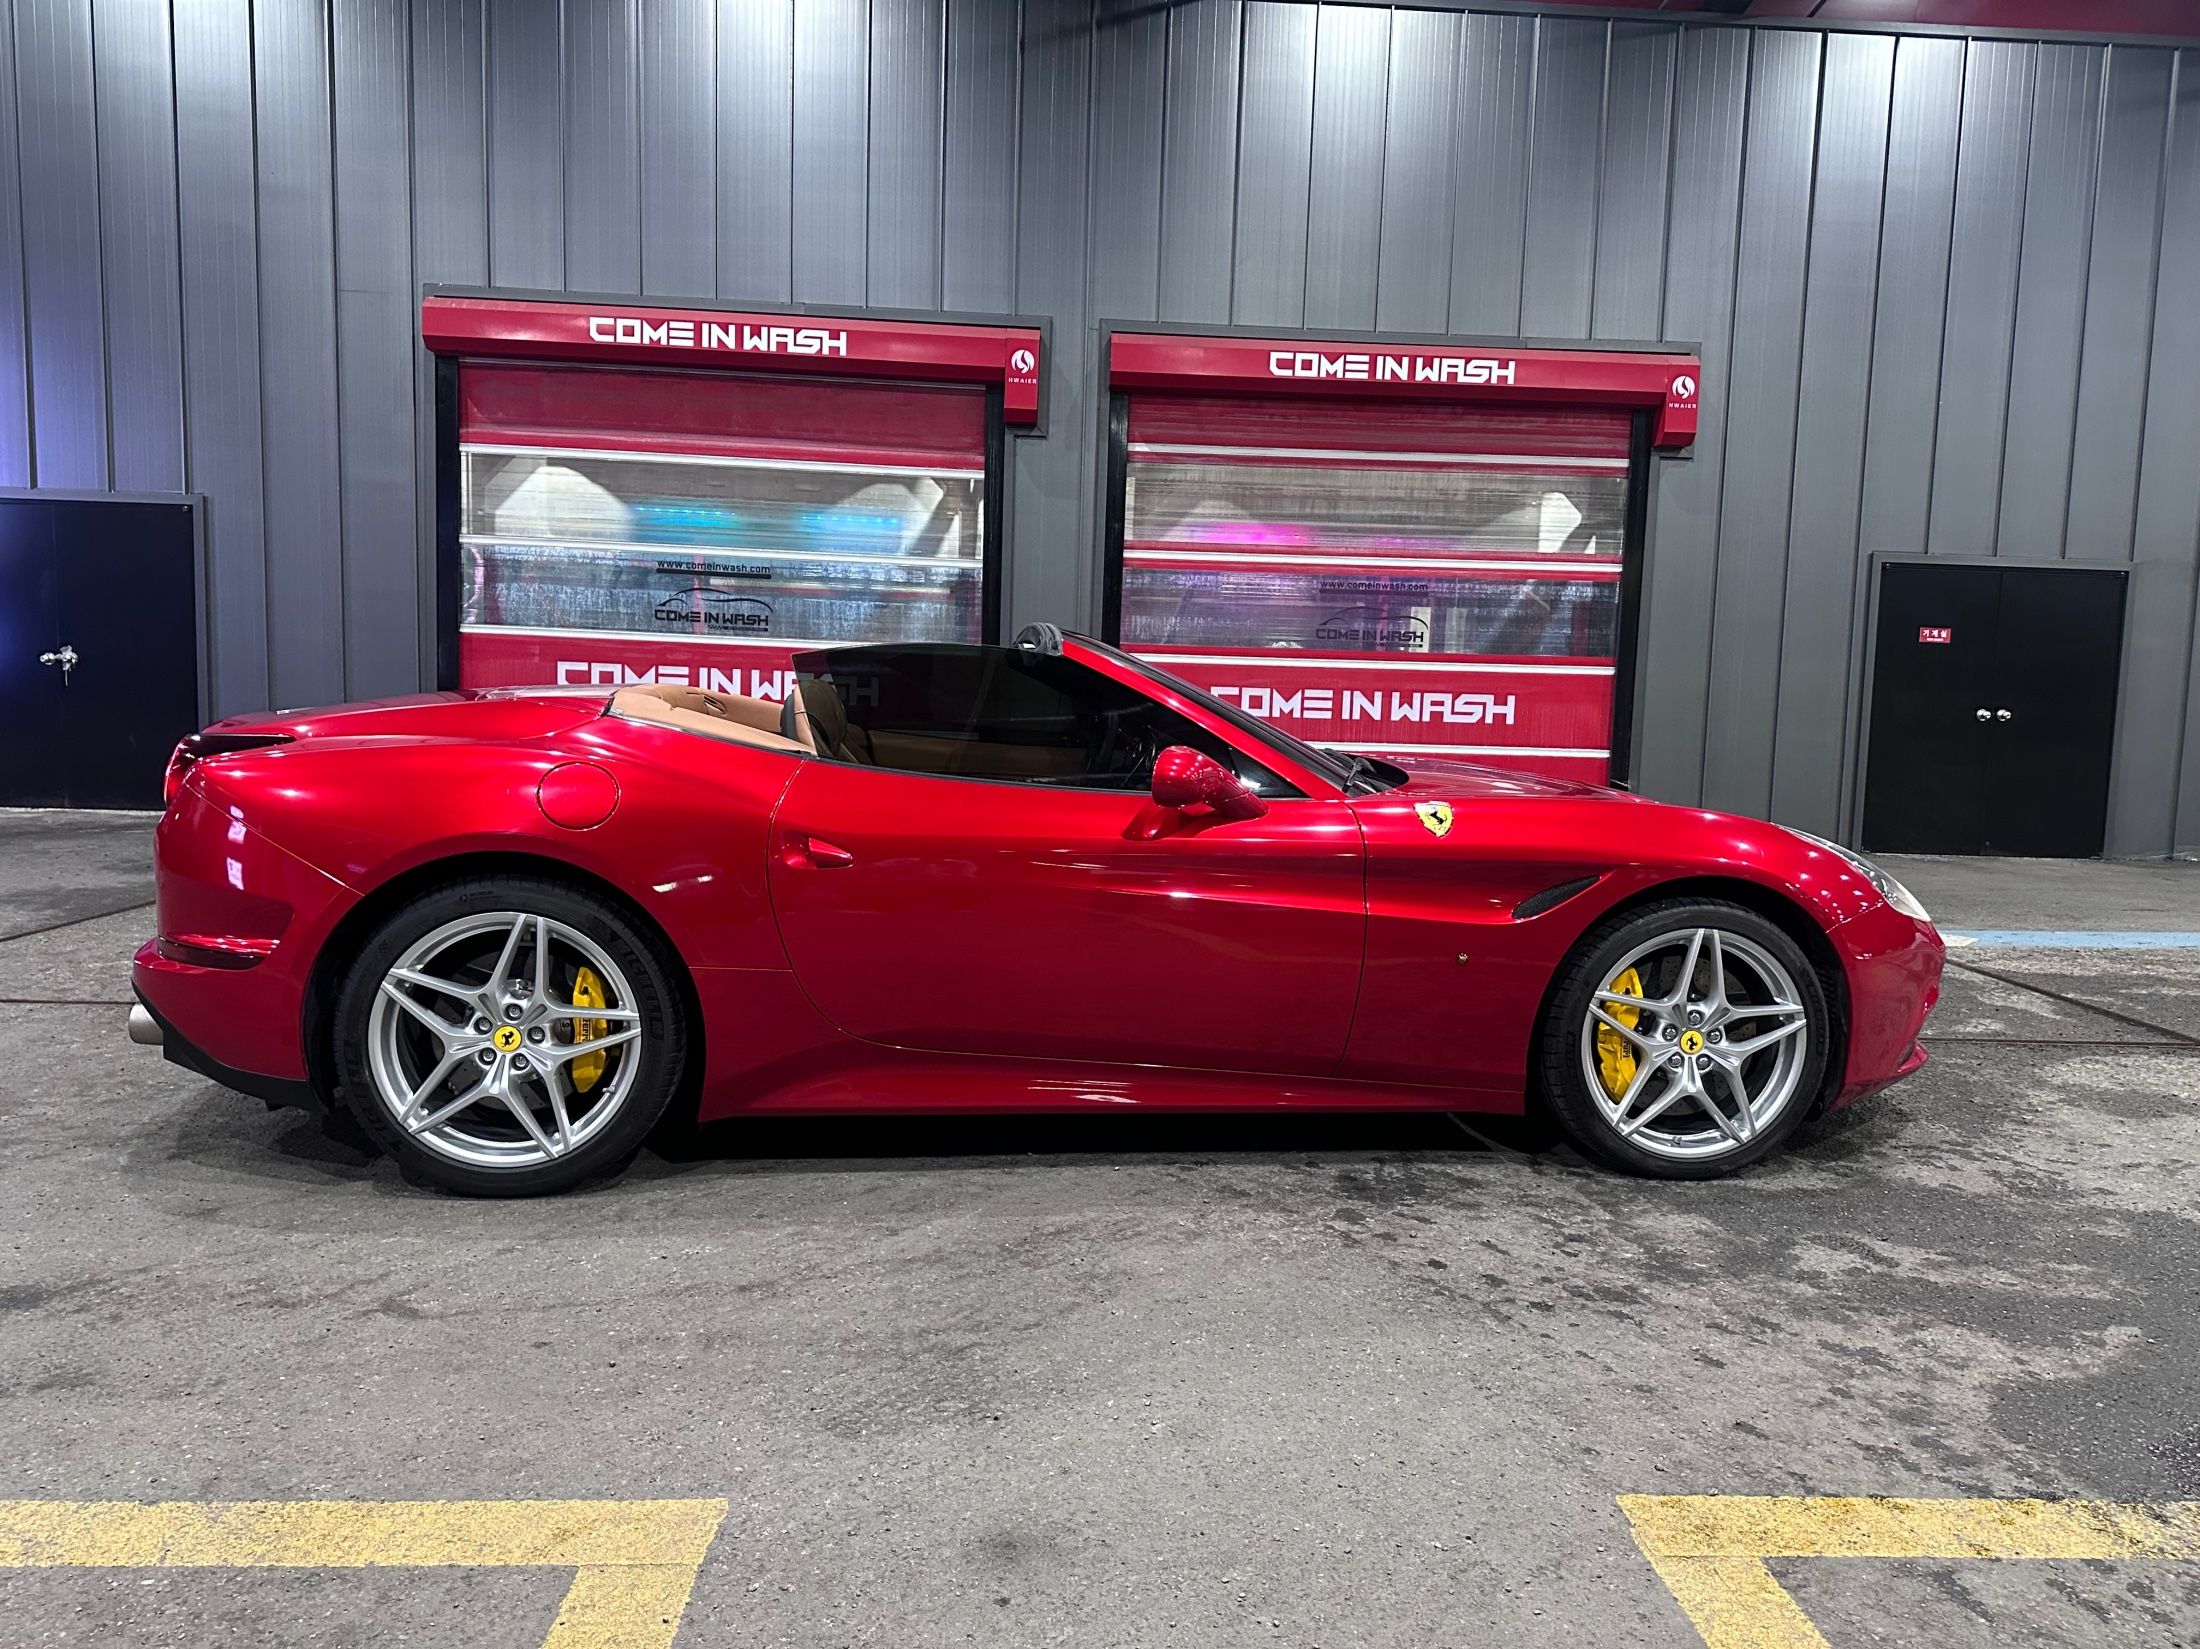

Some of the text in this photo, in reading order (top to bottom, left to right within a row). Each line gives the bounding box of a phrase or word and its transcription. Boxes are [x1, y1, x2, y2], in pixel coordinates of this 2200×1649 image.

[589, 316, 848, 356] COME IN WASH
[1269, 351, 1516, 385] COME IN WASH
[656, 560, 771, 574] www.comeinwash.com
[1320, 581, 1428, 591] www.comeinwash.com
[654, 609, 769, 626] COME IN WASH
[1316, 628, 1424, 643] COME IN WASH
[699, 667, 742, 696] IN
[1342, 689, 1382, 721] IN
[1391, 691, 1516, 725] WASH
